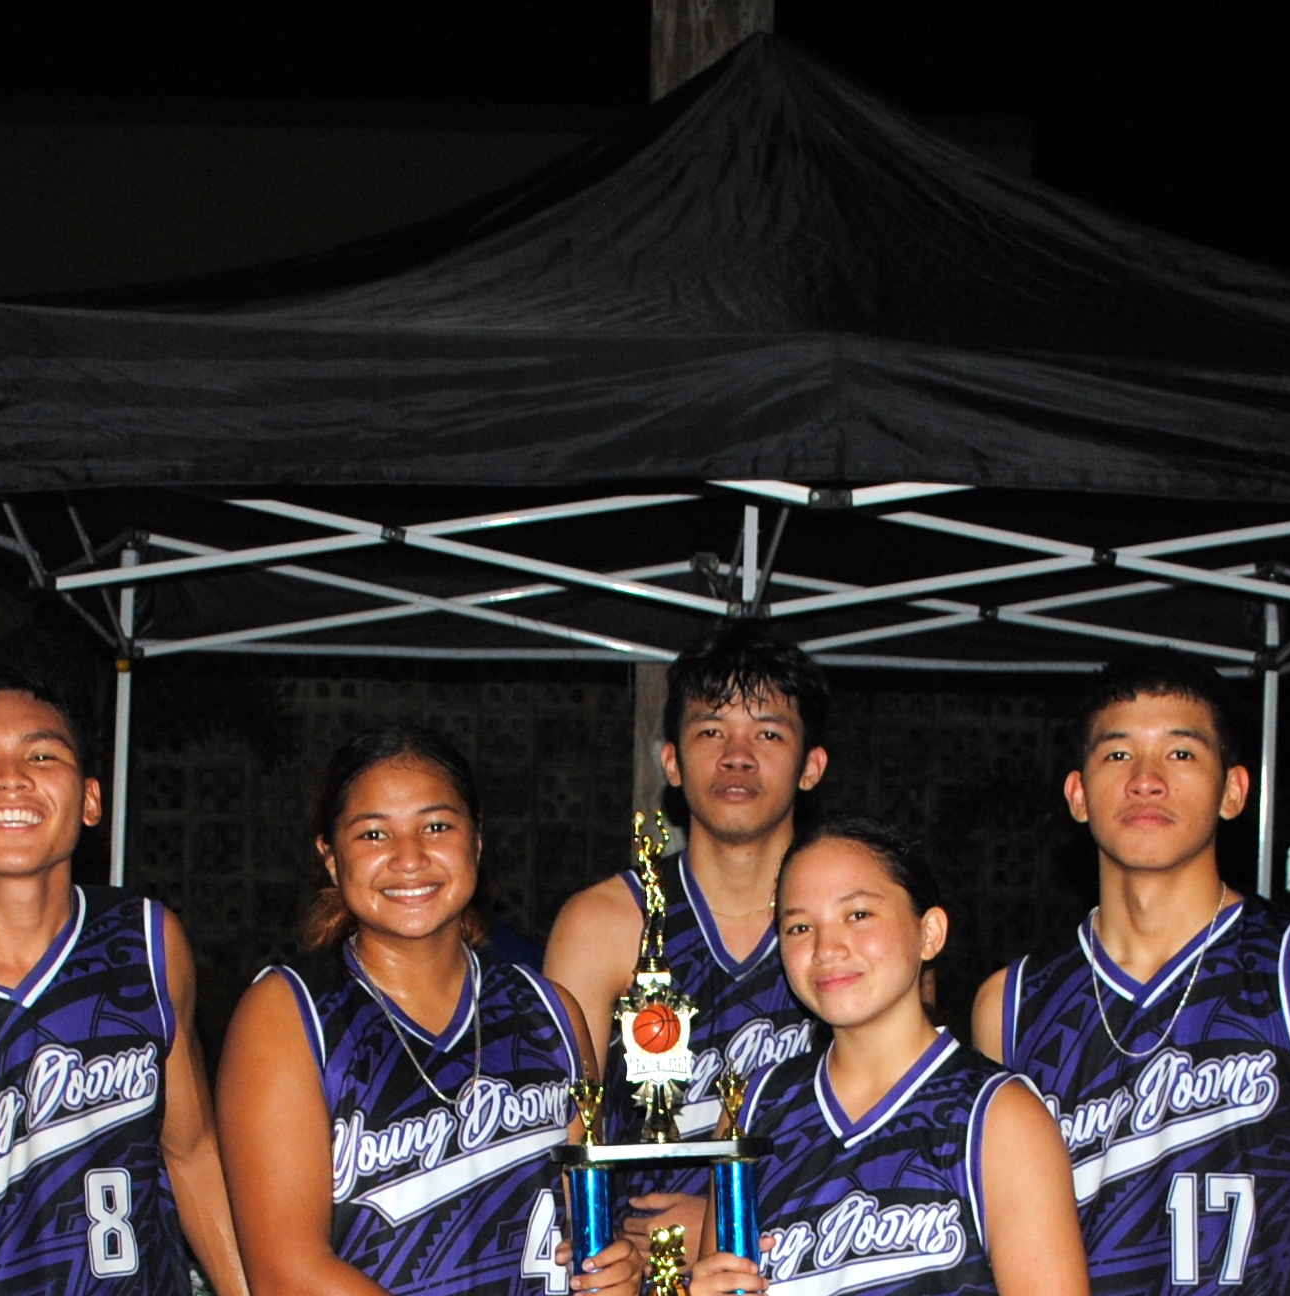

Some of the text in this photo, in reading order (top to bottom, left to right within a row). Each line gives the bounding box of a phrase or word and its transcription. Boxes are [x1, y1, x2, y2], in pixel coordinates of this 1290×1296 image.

[333, 1110, 456, 1203] Young
[1047, 1087, 1134, 1150] oung
[84, 1167, 139, 1279] 8
[1166, 1173, 1255, 1285] 17
